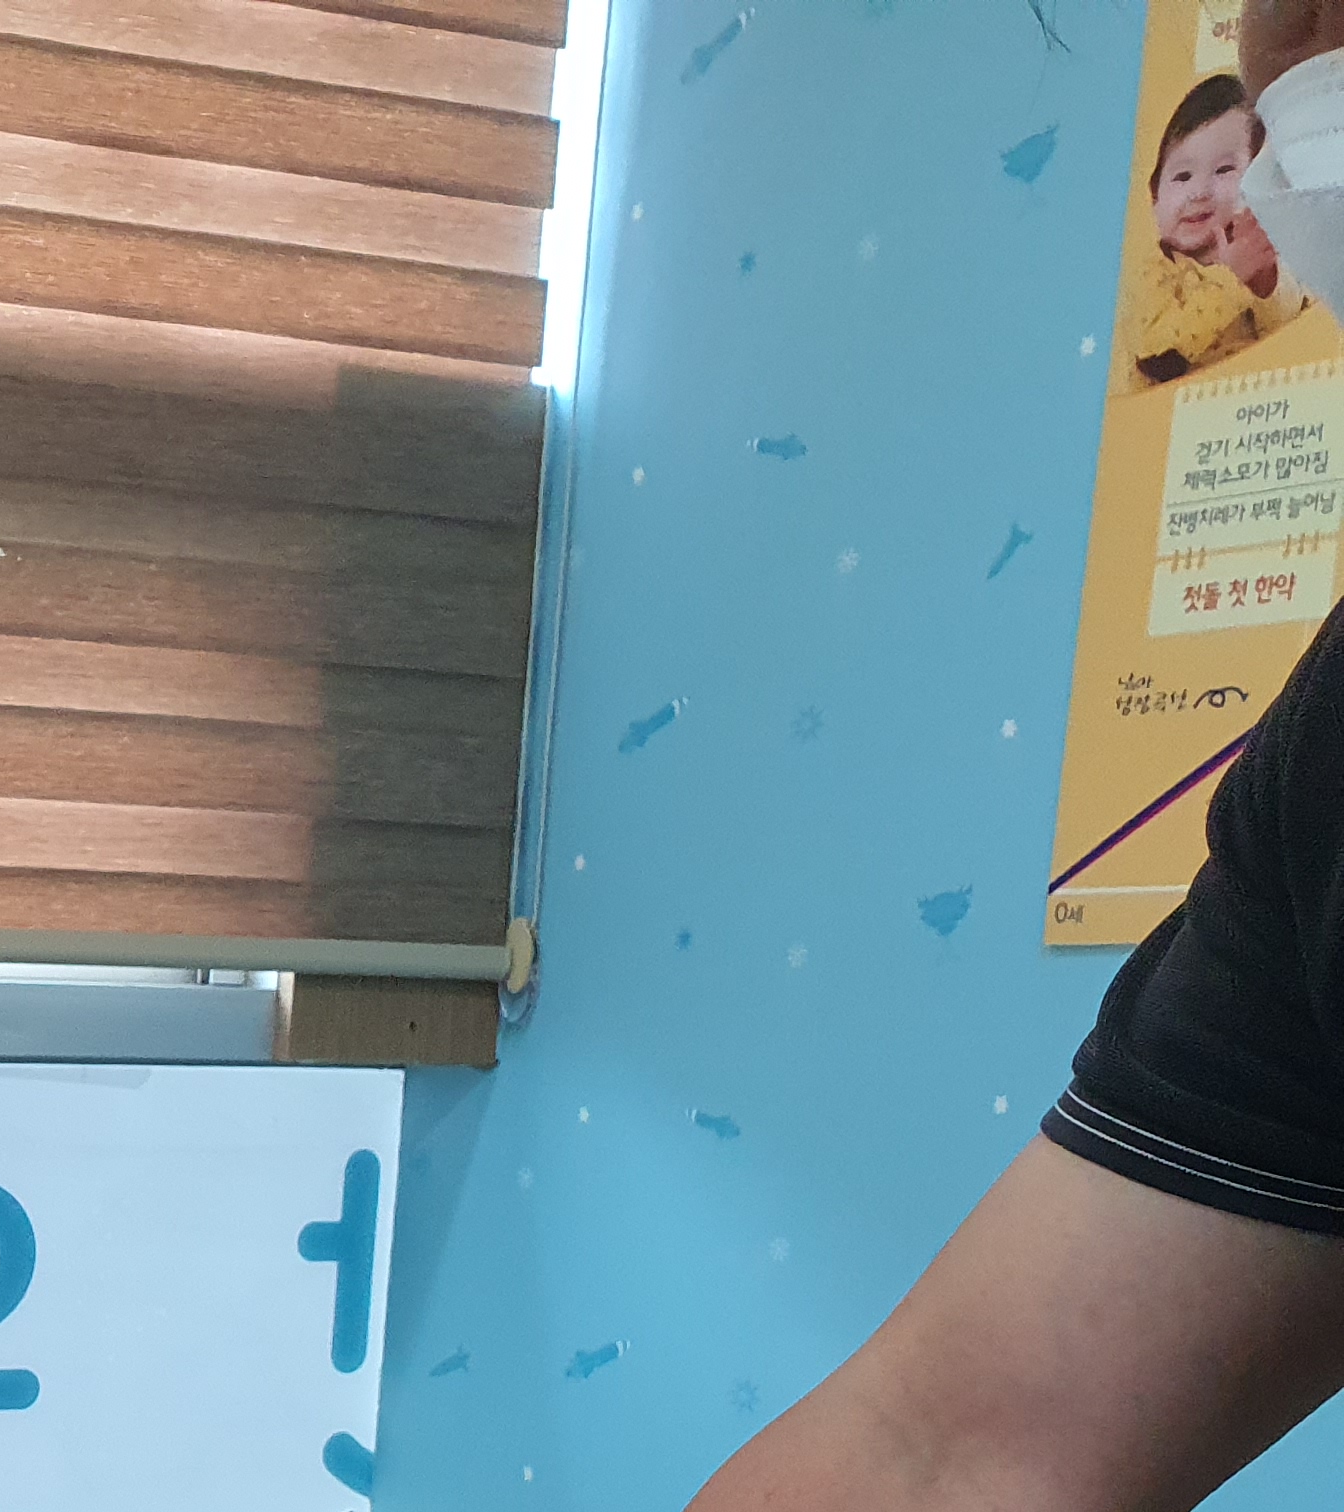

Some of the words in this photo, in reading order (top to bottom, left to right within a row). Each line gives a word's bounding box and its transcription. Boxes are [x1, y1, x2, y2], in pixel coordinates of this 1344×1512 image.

[1236, 399, 1290, 425] 아이가
[1195, 439, 1230, 465] 걷기
[1235, 423, 1324, 455] 시작하면서
[1183, 459, 1271, 491] 체력소모가
[1275, 450, 1330, 481] 많아짐
[1255, 571, 1297, 605] 한약
